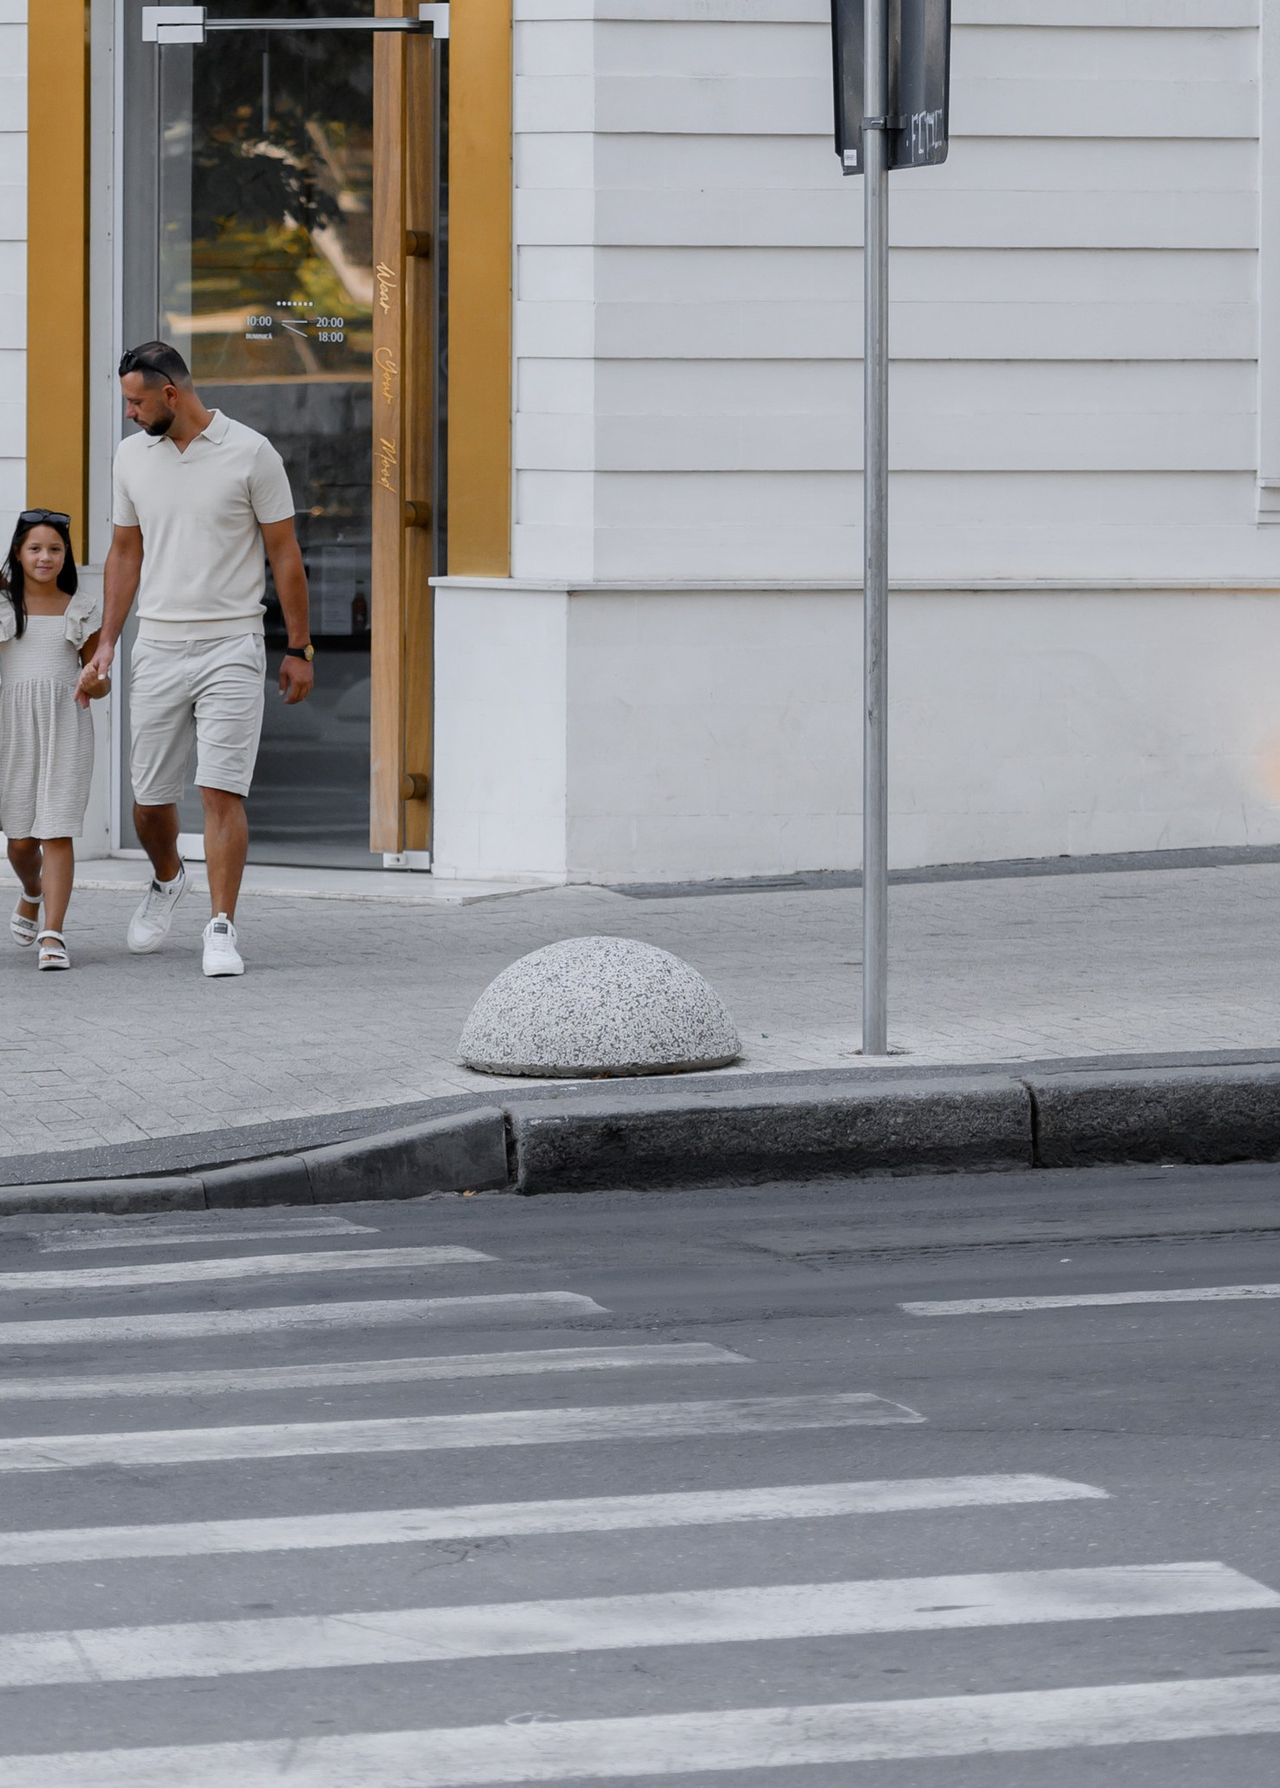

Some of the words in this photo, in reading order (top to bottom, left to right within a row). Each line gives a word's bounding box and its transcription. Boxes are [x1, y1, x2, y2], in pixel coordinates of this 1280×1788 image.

[376, 261, 397, 315] Wear
[246, 316, 272, 327] 10:00
[316, 317, 344, 328] 20:00
[318, 332, 344, 343] 18:00
[375, 346, 398, 405] Your
[376, 437, 398, 493] Mood
